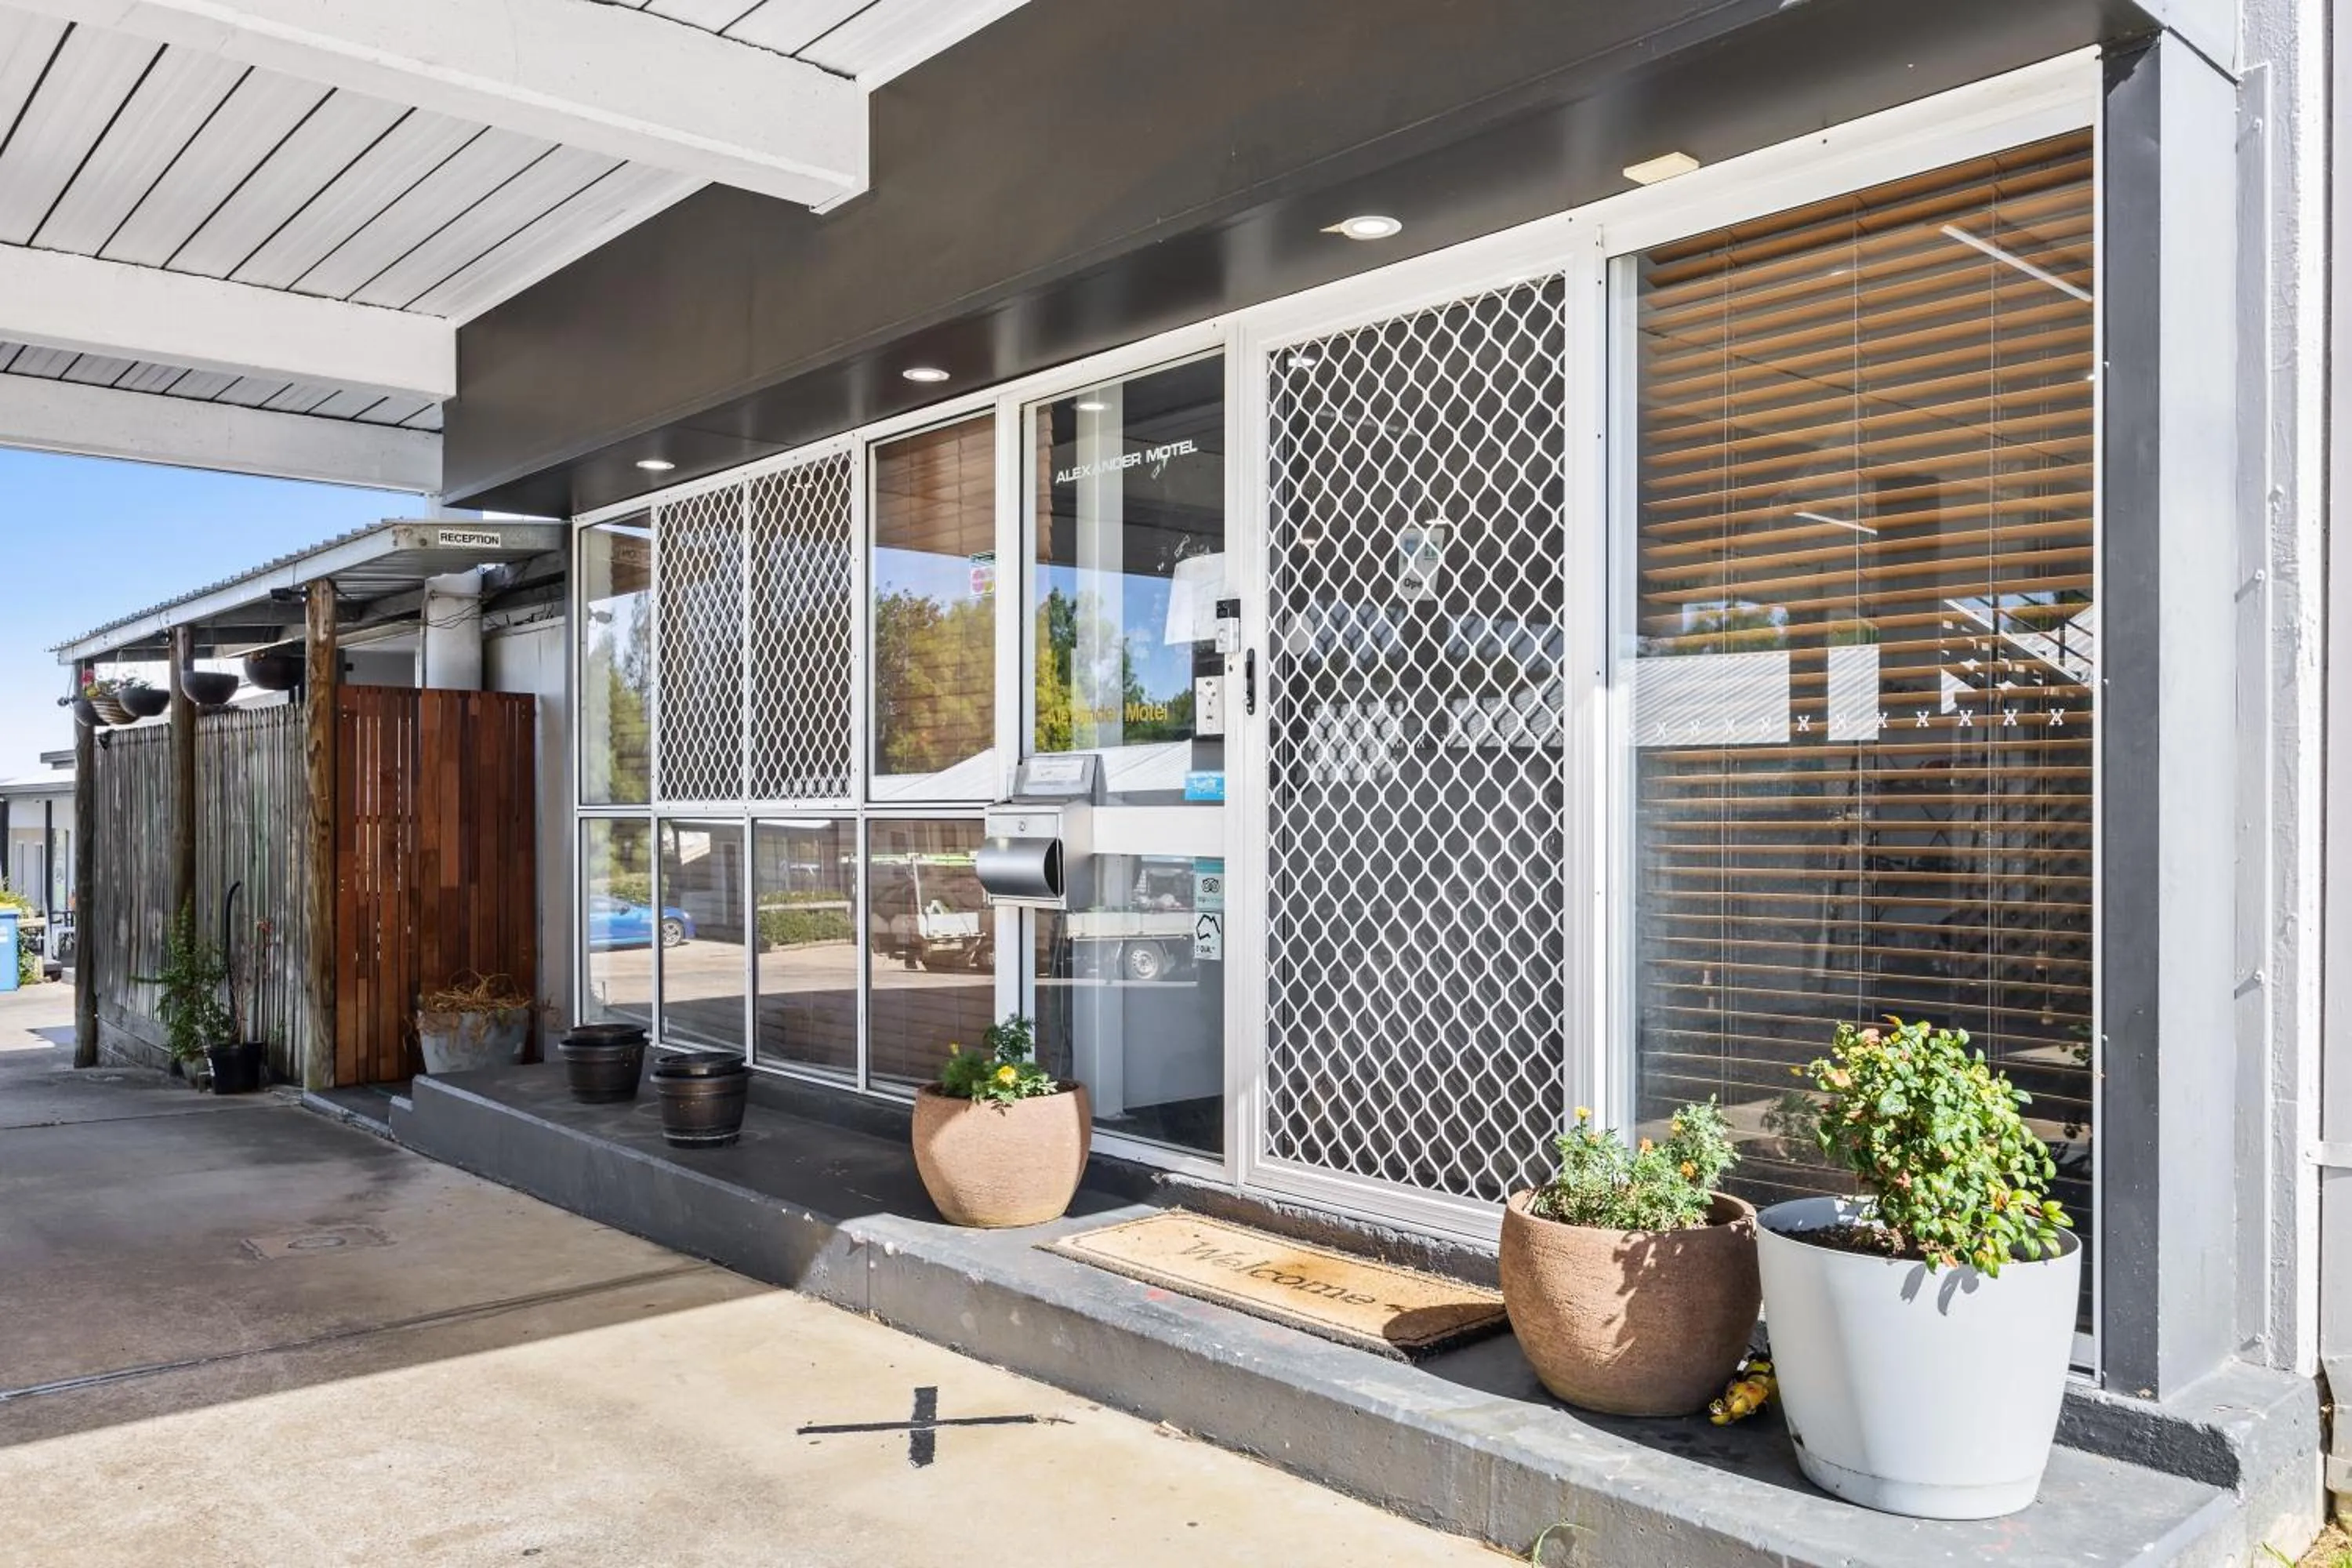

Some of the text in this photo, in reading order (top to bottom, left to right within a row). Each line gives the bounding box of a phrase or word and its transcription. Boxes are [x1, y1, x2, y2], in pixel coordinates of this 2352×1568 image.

[1055, 440, 1198, 484] ALEXANDER MOTEL
[441, 533, 499, 545] RECEPTION
[1404, 578, 1426, 590] Ope
[1126, 702, 1167, 722] Motel
[1181, 1240, 1377, 1305] Welcome
